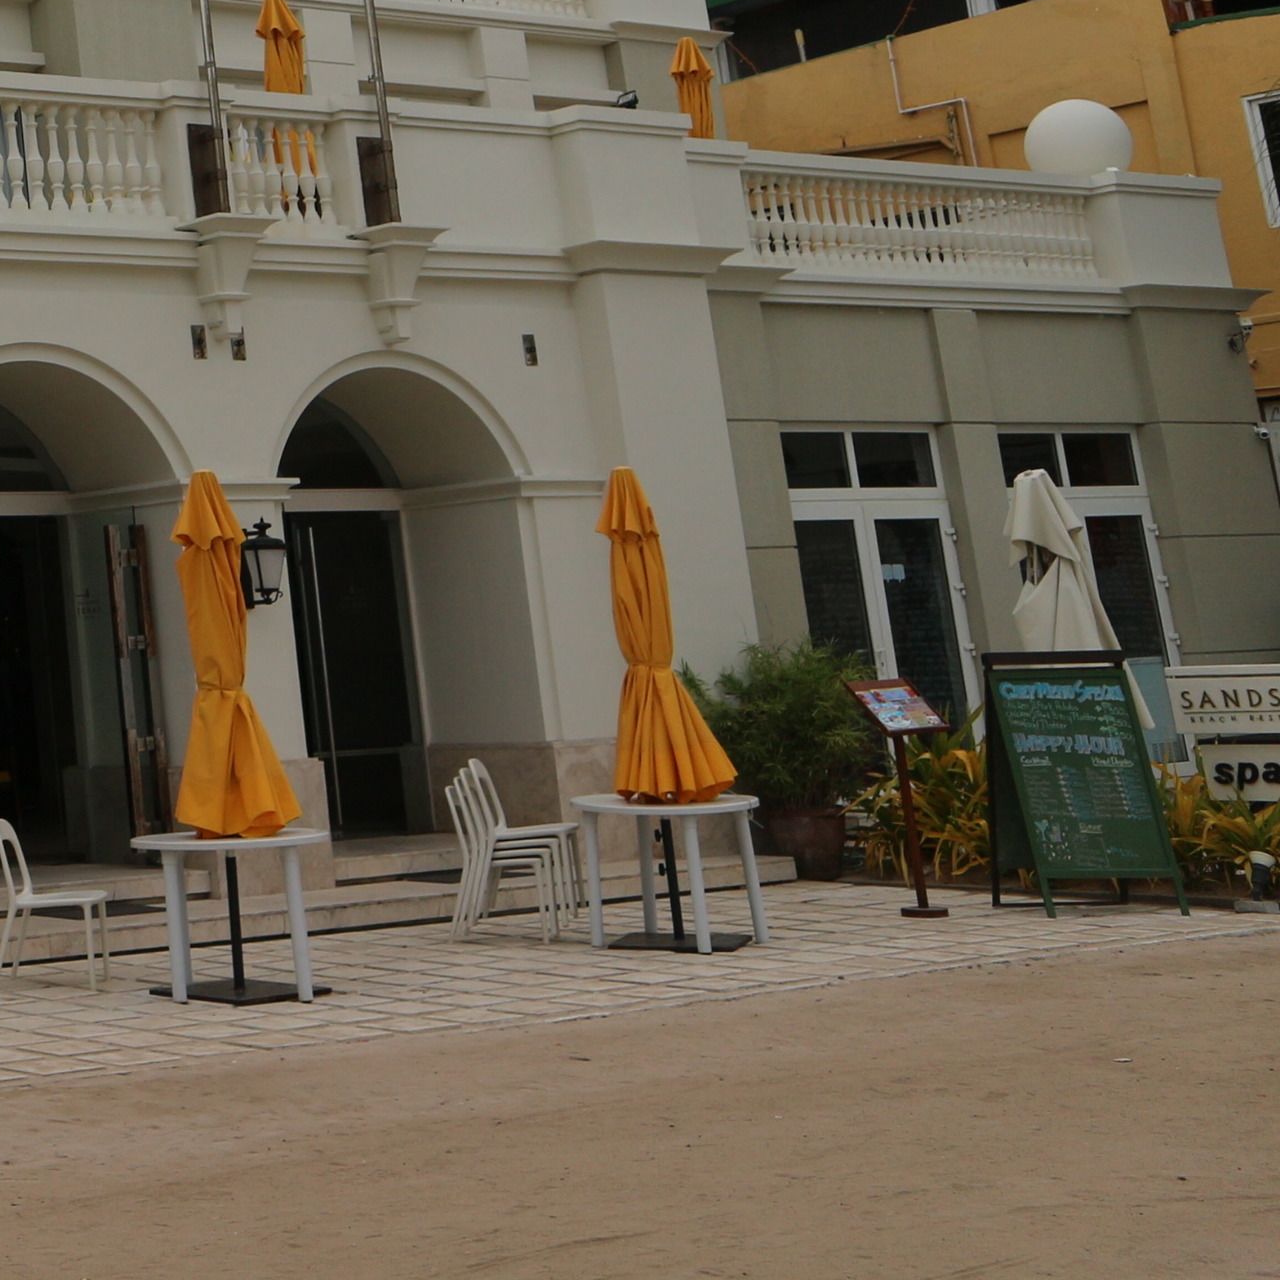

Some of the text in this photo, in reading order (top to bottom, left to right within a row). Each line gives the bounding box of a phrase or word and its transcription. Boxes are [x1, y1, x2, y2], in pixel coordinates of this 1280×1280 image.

[1181, 687, 1280, 709] SANDS
[1190, 714, 1237, 724] BEACH
[1213, 762, 1280, 791] spa
